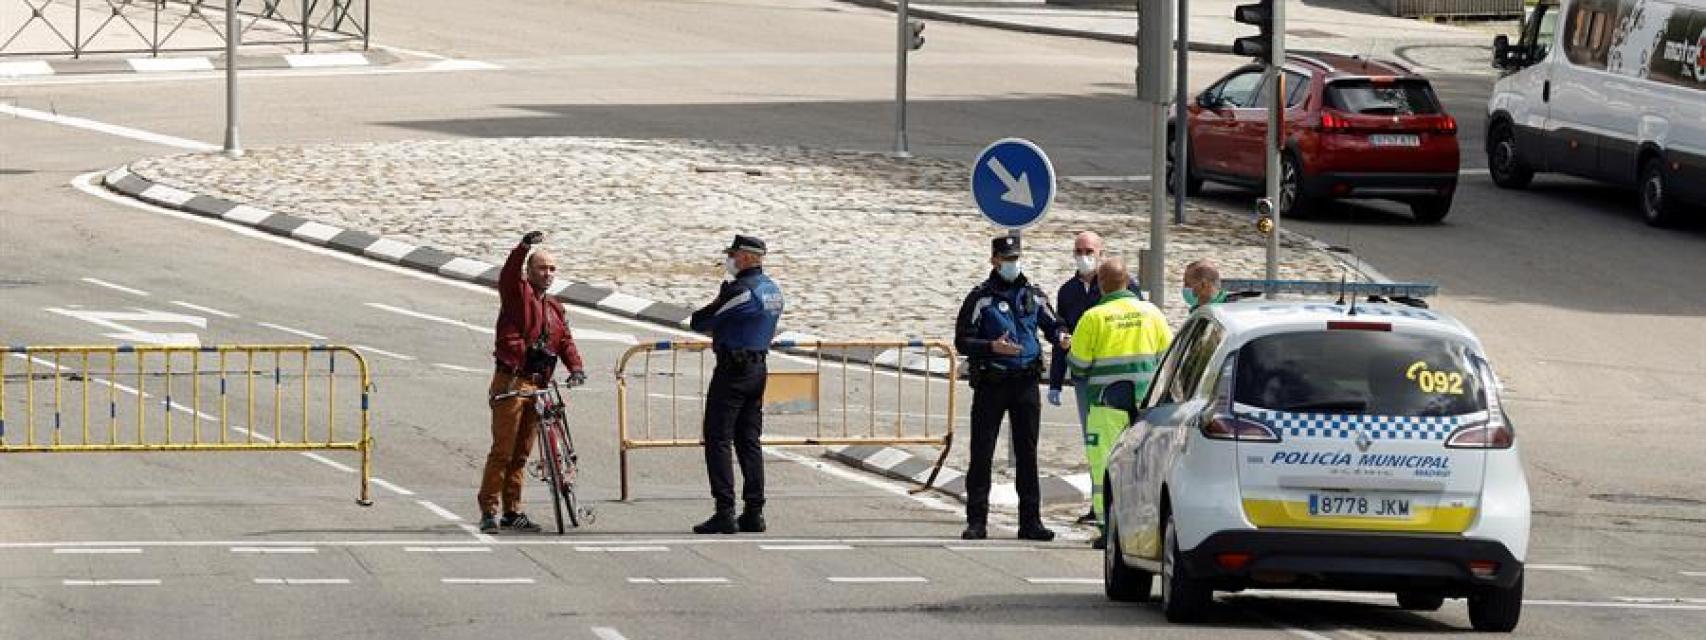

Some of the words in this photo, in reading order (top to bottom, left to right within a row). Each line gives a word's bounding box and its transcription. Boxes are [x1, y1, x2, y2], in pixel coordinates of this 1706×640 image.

[1418, 370, 1464, 395] 092
[1358, 454, 1450, 470] MUNICIPAL
[1321, 497, 1369, 514] 8778
[1375, 499, 1410, 516] JKM
